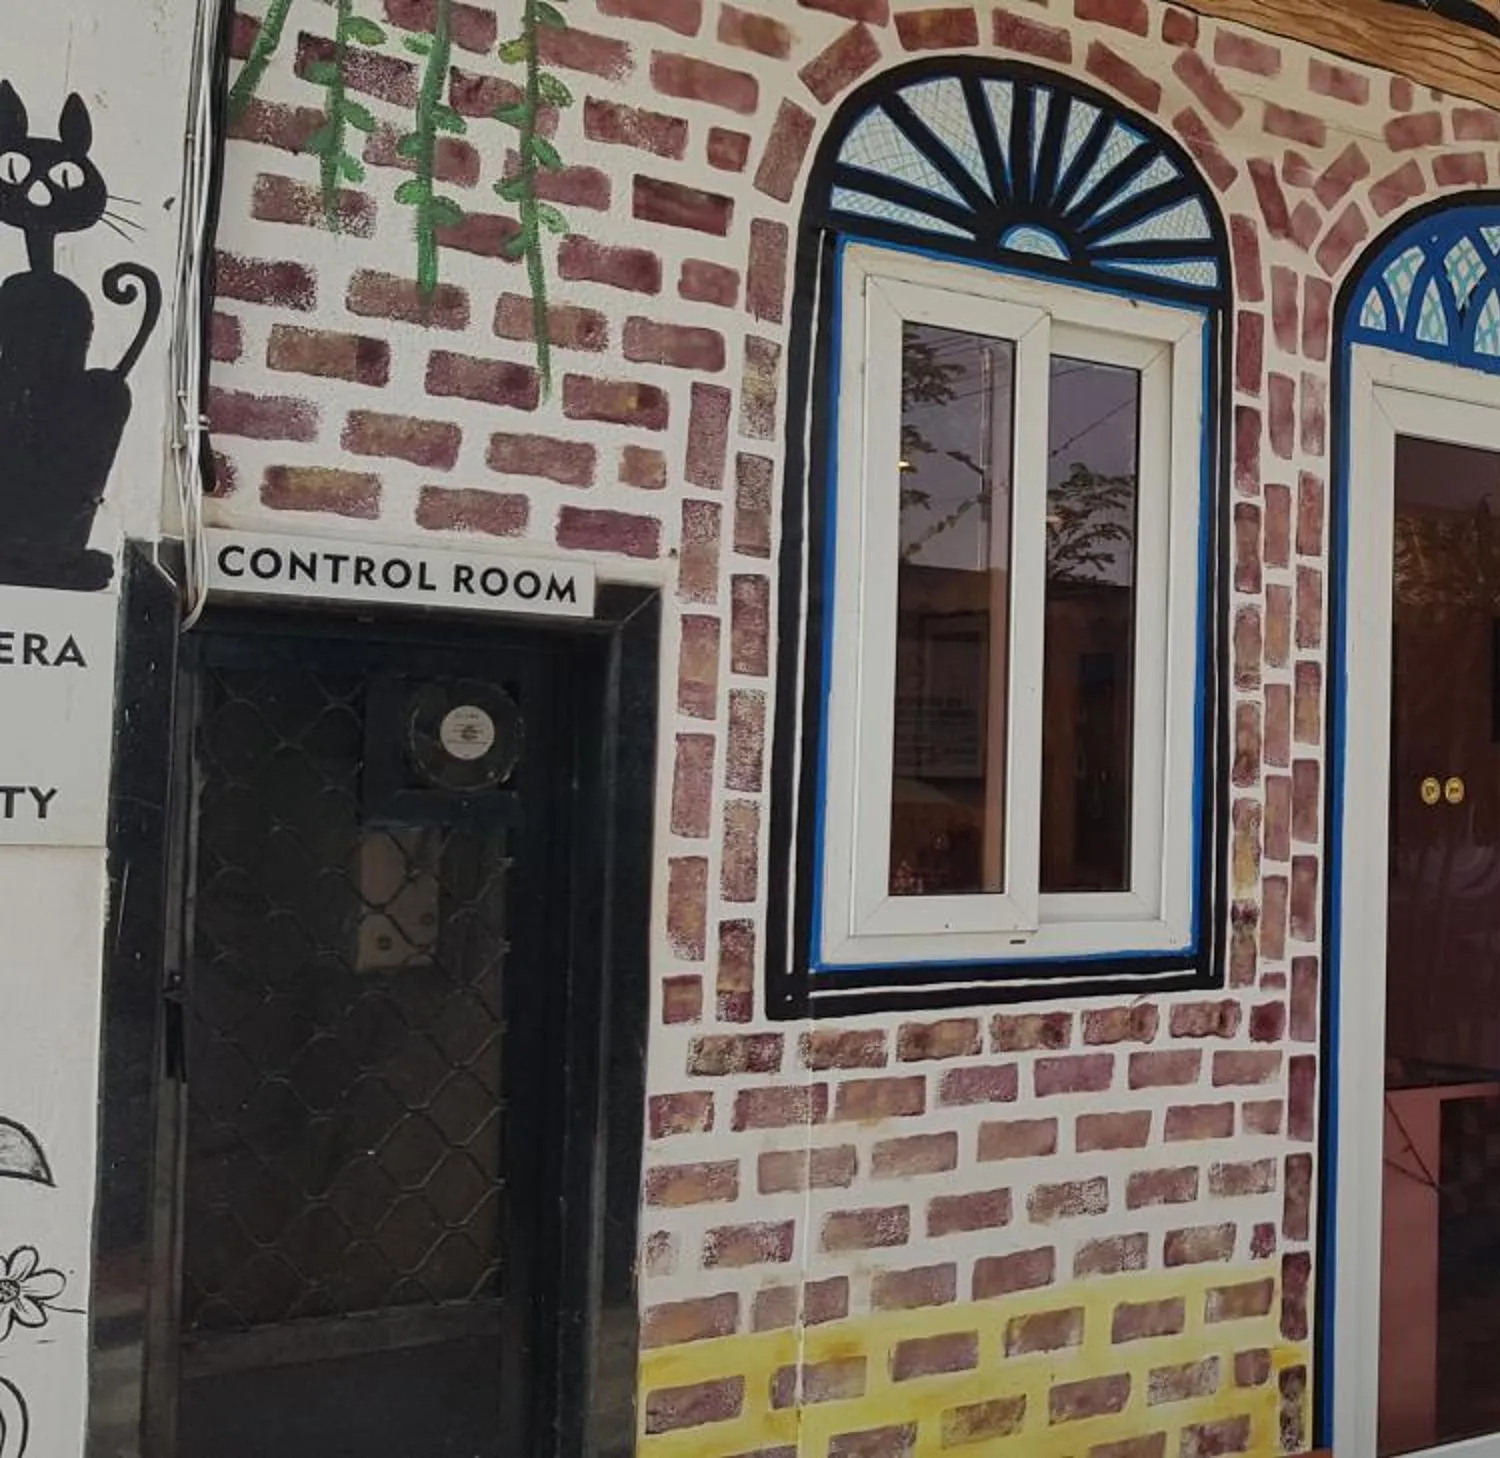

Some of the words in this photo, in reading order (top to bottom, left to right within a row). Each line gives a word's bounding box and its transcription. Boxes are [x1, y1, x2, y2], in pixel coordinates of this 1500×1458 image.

[217, 545, 437, 591] CONTROL
[453, 564, 577, 603] ROOM
[0, 631, 87, 668] ERA
